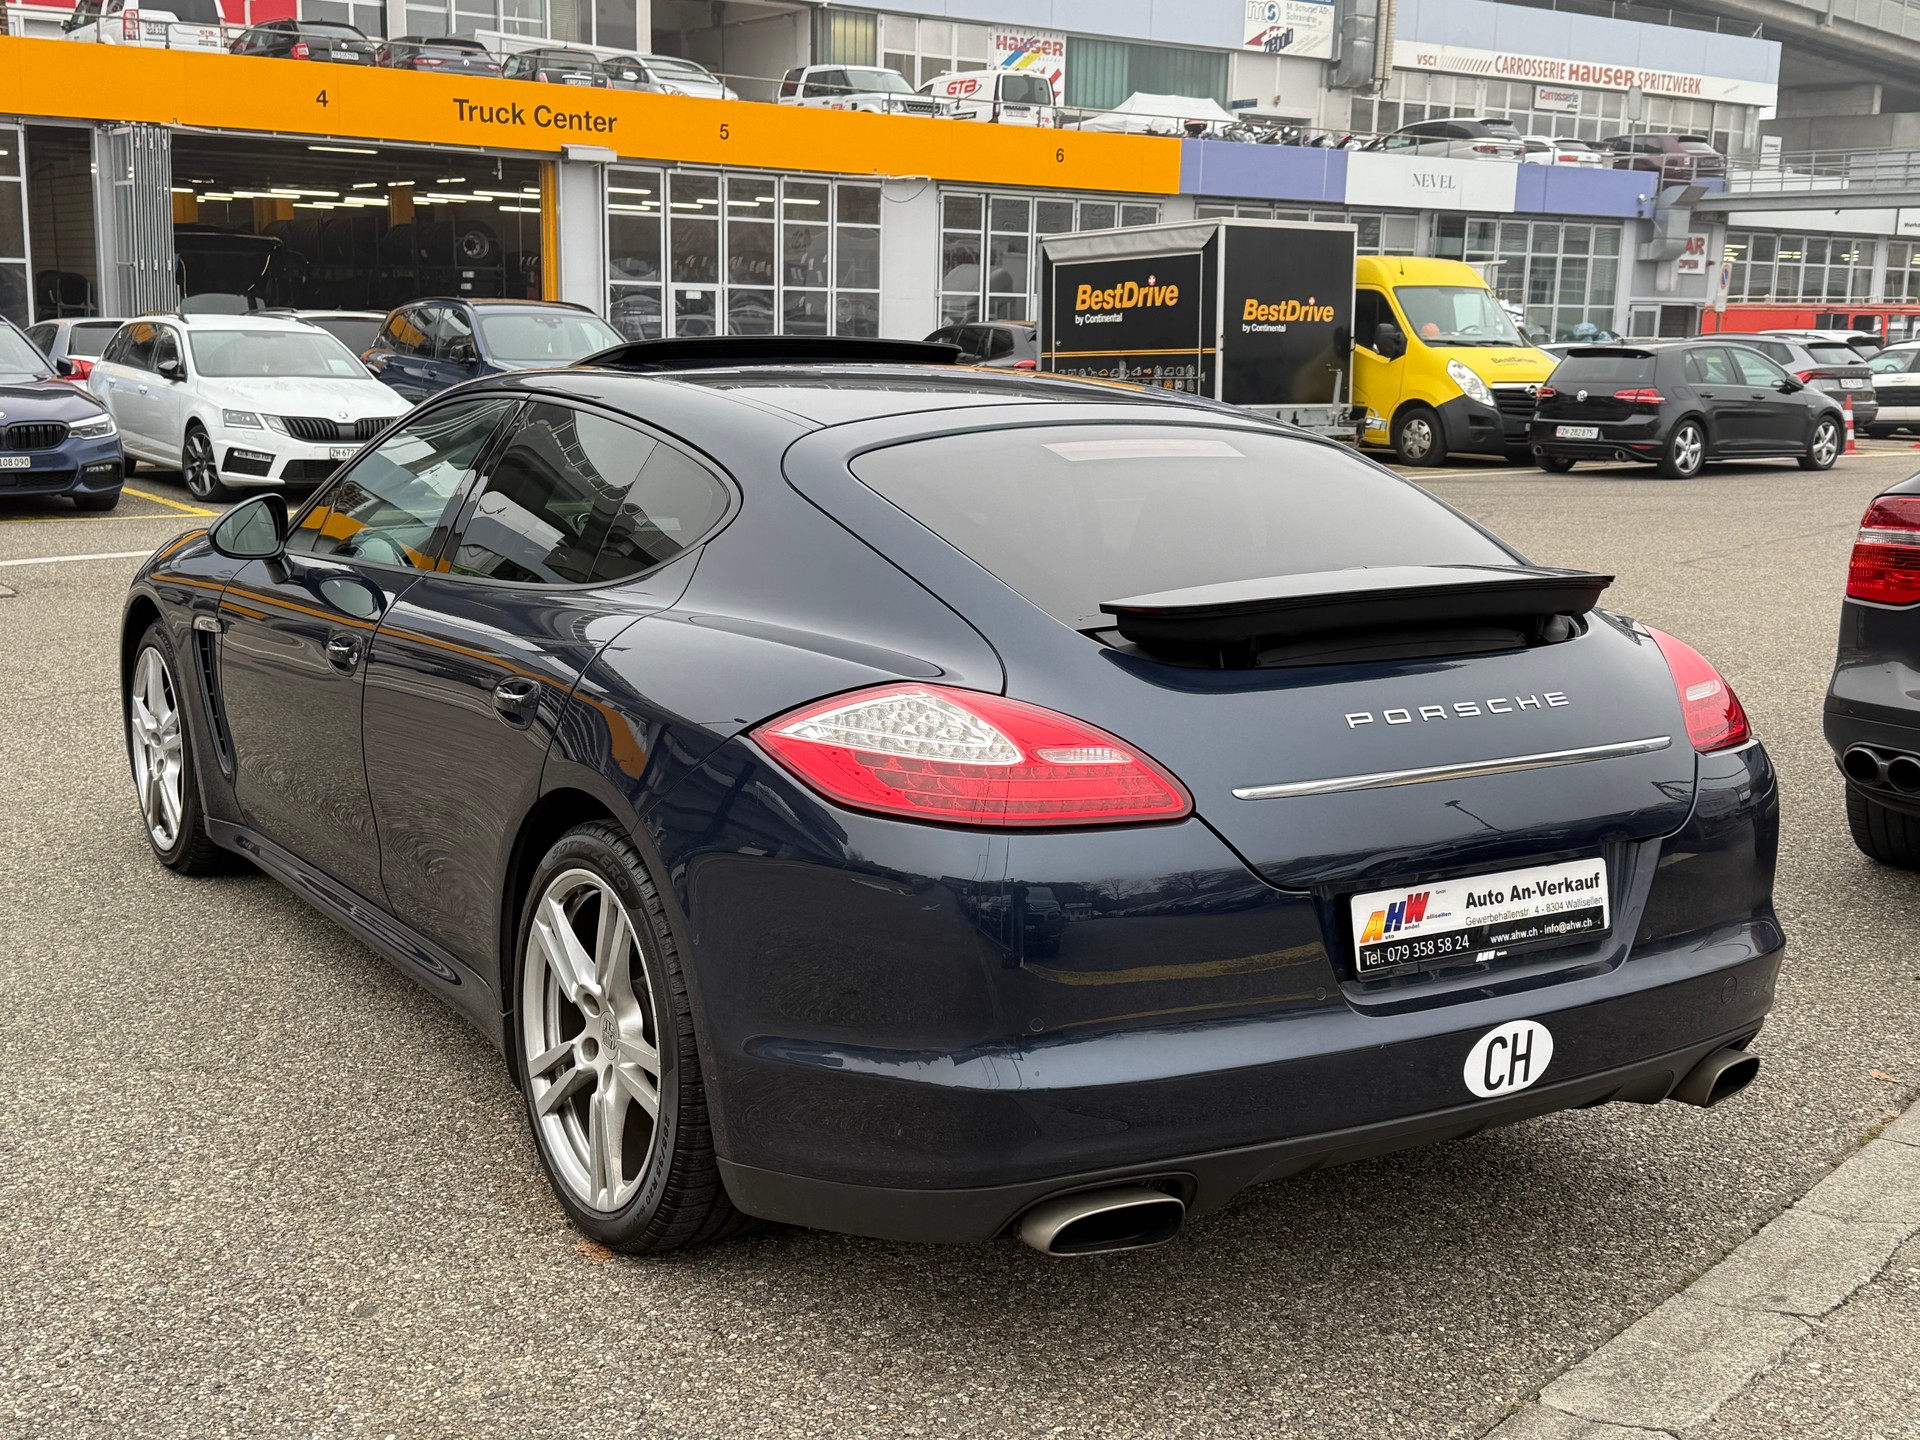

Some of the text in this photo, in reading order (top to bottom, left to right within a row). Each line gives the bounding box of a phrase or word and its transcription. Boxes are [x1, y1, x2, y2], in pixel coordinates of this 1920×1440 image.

[1417, 54, 1437, 66] VSCI
[1495, 55, 1566, 80] CARROSSERIE
[1639, 71, 1702, 95] SPRITZWERK
[316, 89, 329, 108] 4
[452, 98, 618, 133] Truck Center
[719, 123, 730, 141] 5
[1055, 147, 1065, 163] 6
[1412, 173, 1457, 189] NEVEL
[1075, 276, 1179, 311] BestDrive
[1075, 313, 1123, 326] by Continental
[1243, 297, 1334, 322] BestDrive
[1242, 324, 1286, 333] by Continental
[332, 449, 341, 457] ZH
[1344, 692, 1570, 729] PORSCHE
[1465, 872, 1600, 909] Auto An-Verkauf
[1360, 891, 1430, 943] AHW
[1466, 908, 1531, 926] Gewerbehallenstr.
[1534, 905, 1539, 914] 4
[1546, 901, 1564, 913] 8304
[1565, 895, 1603, 909] Wallisellen
[1490, 927, 1538, 944] www.ahw.ch
[1544, 918, 1592, 934] info@ahw.ch
[1363, 934, 1470, 966] Tel. 079 358 58 24
[1476, 950, 1495, 962] AHW
[1484, 1029, 1533, 1091] CH
[645, 1179, 658, 1205] R20
